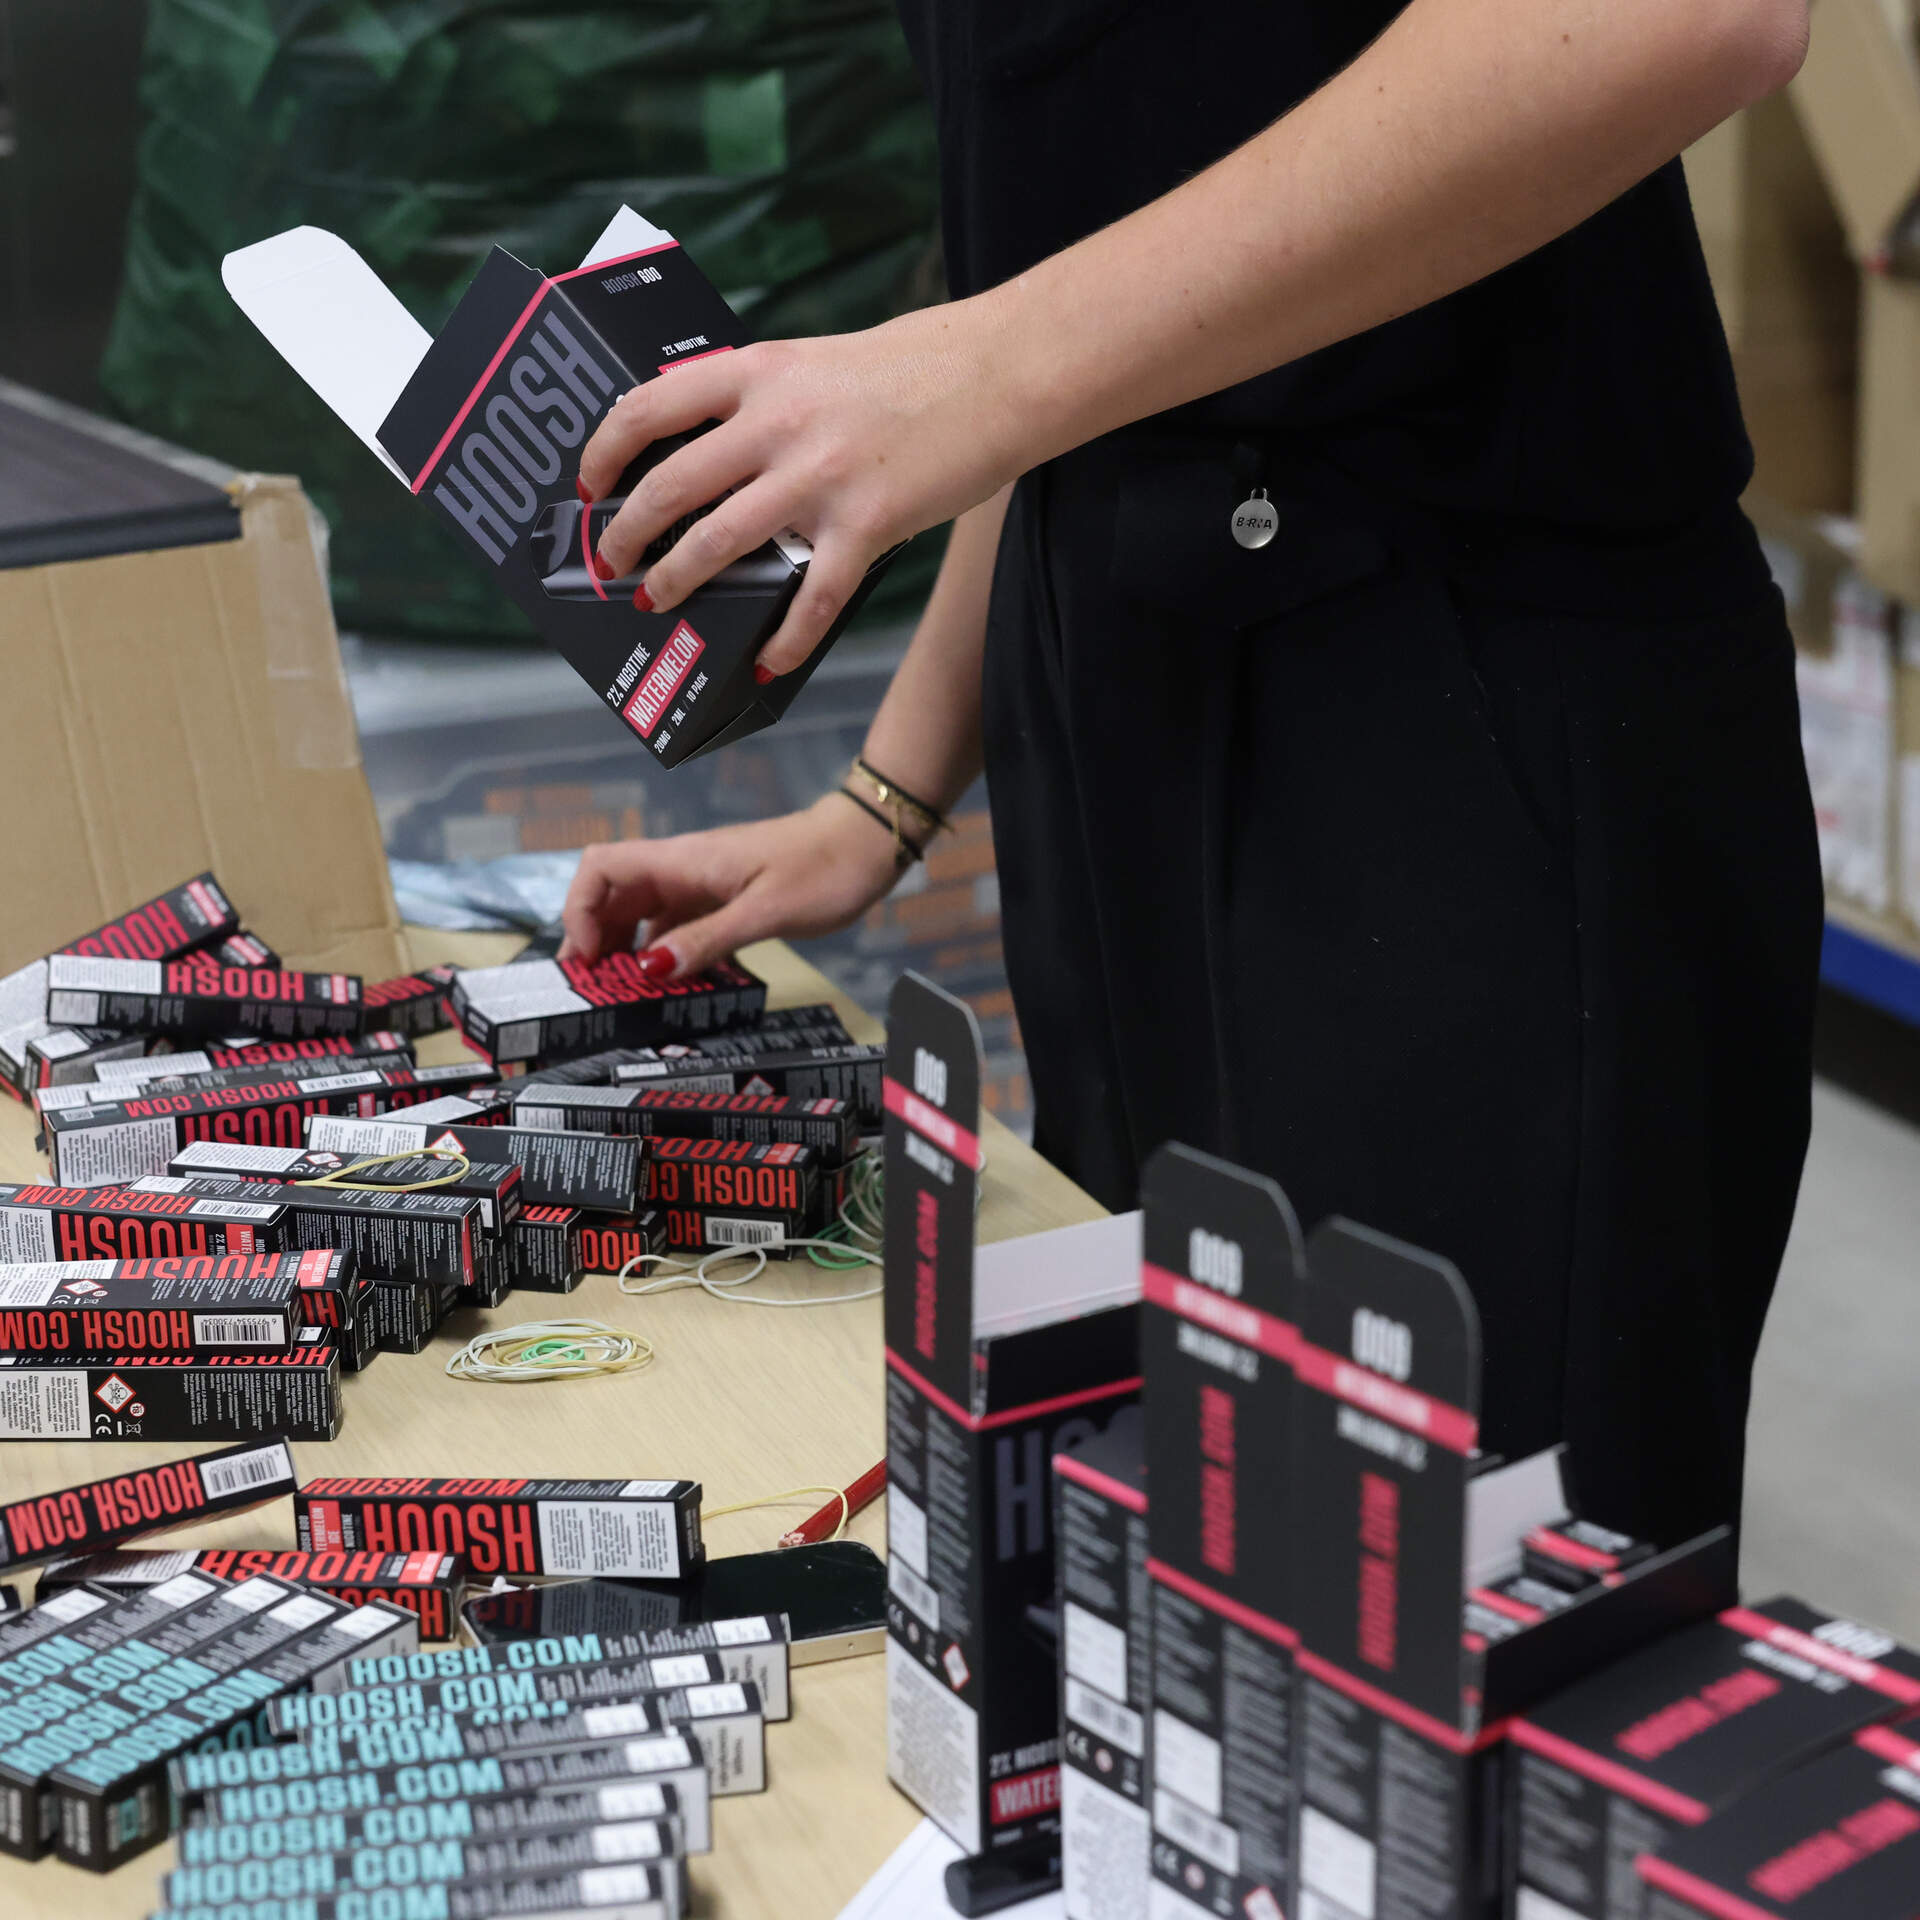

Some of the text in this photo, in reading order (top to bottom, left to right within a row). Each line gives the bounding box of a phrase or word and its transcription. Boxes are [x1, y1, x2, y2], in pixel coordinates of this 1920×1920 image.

[601, 266, 662, 294] HOOSH 600
[662, 335, 710, 356] 2% NICOTINE
[433, 310, 615, 566] HOOSH
[606, 642, 651, 707] 2% NICOTINE
[627, 628, 699, 729] WATERMELON
[691, 672, 709, 696] PACK
[671, 707, 686, 727] 2ML
[686, 693, 697, 703] 10
[653, 730, 671, 754] 20MG
[168, 964, 304, 1001] HOOSH
[213, 1037, 354, 1069] HOOSH
[124, 1081, 299, 1117] HOOSH.COM
[638, 1089, 790, 1113] HOOSH
[13, 1185, 197, 1214] HOOSH.COM
[59, 1213, 207, 1260] HOOSH
[0, 1311, 190, 1349] HOOSH.COM
[6, 1460, 205, 1556] HOOSH.COM
[300, 1478, 528, 1497] HOOSH.COM
[362, 1502, 536, 1573] HOOSH
[200, 1550, 386, 1582] HOOSH
[351, 1634, 603, 1688] HOOSH.COM
[0, 1656, 220, 1777] HOOSH.COM
[280, 1671, 538, 1730] HOOSH.COM
[60, 1668, 285, 1788] HOOSH.COM
[184, 1722, 465, 1791] HOOSH.COM
[220, 1758, 504, 1823] HOOSH.COM
[184, 1802, 474, 1863] HOOSH.COM
[170, 1840, 464, 1903] HOOSH.COM
